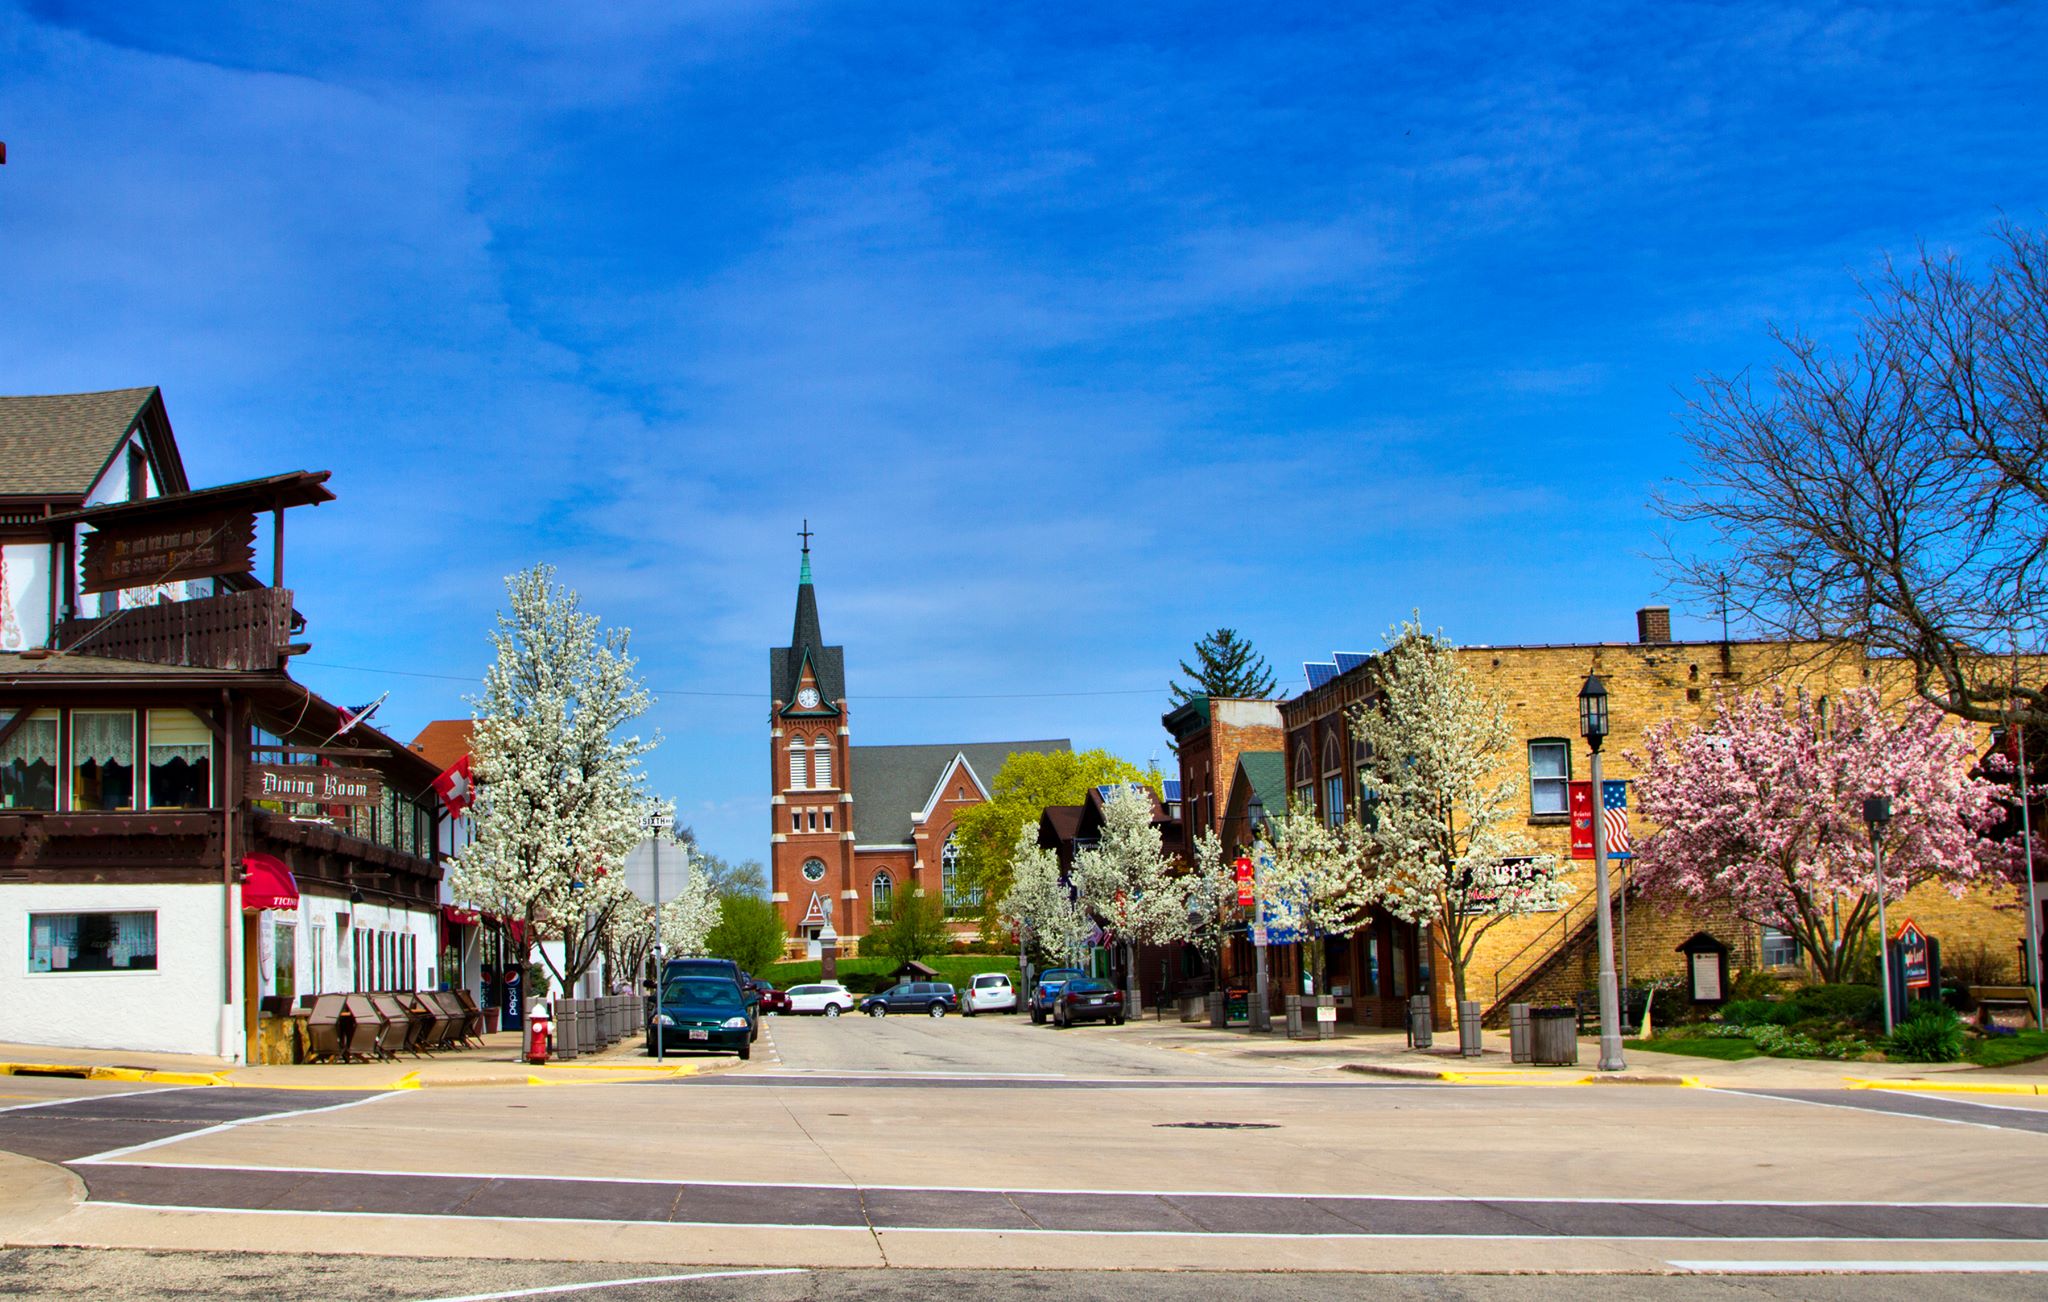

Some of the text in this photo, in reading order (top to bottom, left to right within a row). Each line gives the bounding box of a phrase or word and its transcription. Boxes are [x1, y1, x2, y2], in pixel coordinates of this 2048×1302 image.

[262, 771, 367, 800] Dining Room
[642, 817, 665, 825] SIXTH
[508, 987, 518, 1016] pepsi
